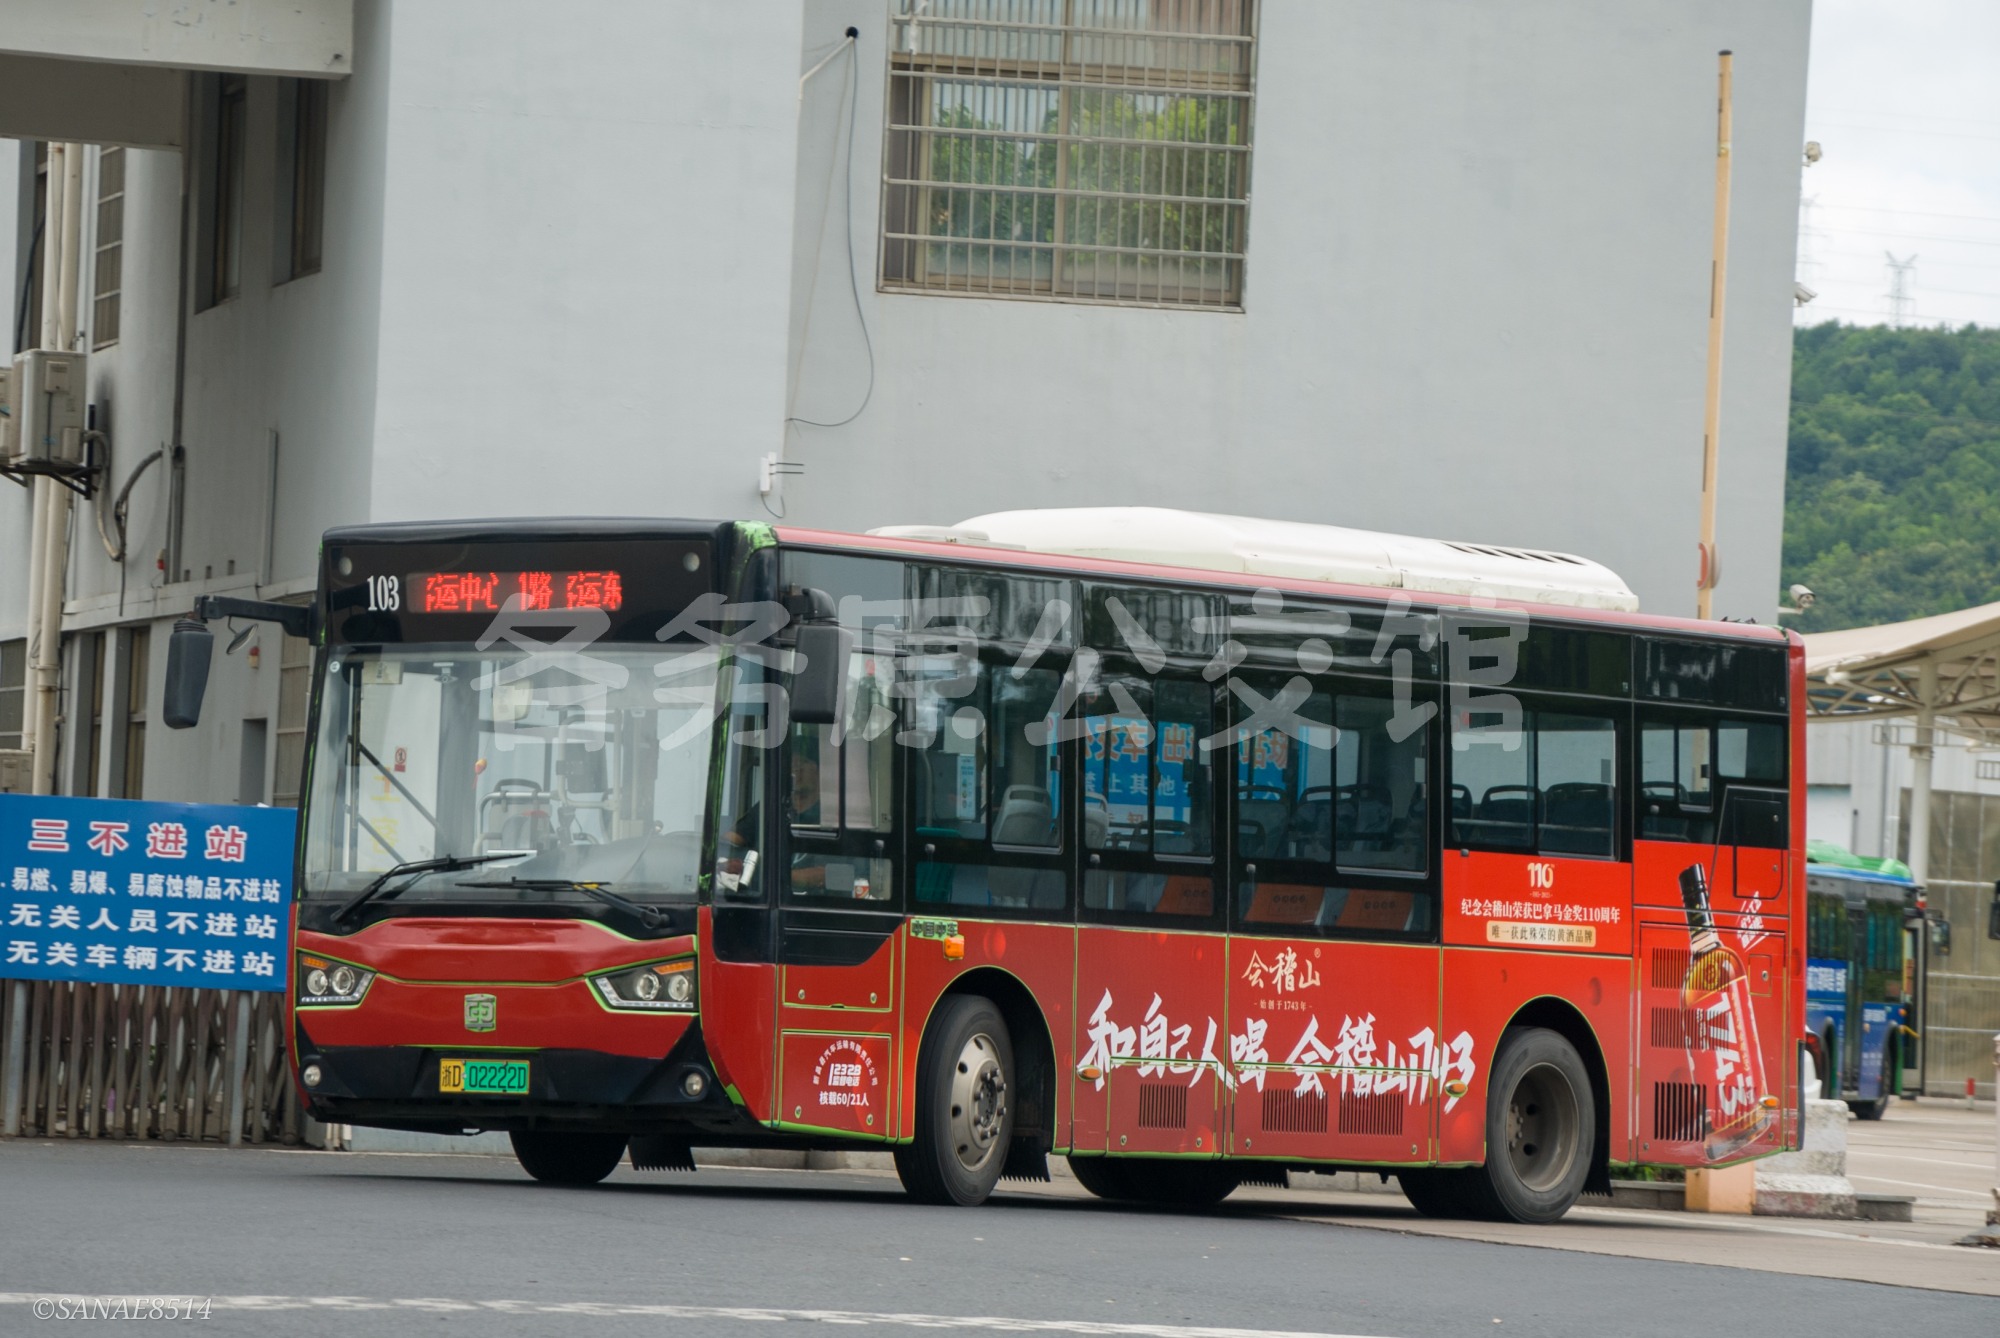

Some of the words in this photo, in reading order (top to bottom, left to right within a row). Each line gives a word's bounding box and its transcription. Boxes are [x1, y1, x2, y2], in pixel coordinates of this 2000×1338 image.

[367, 574, 399, 611] 103
[27, 818, 248, 863] 三不进站
[1460, 898, 1621, 924] 纪念会稽山荣获巴拿马金奖110周年
[1491, 925, 1593, 944] 唯一获此殊荣的黄酒品牌
[5, 940, 276, 976] 无关车辆不进站
[828, 1063, 862, 1084] 12328
[819, 1091, 869, 1107] 核载60/21人
